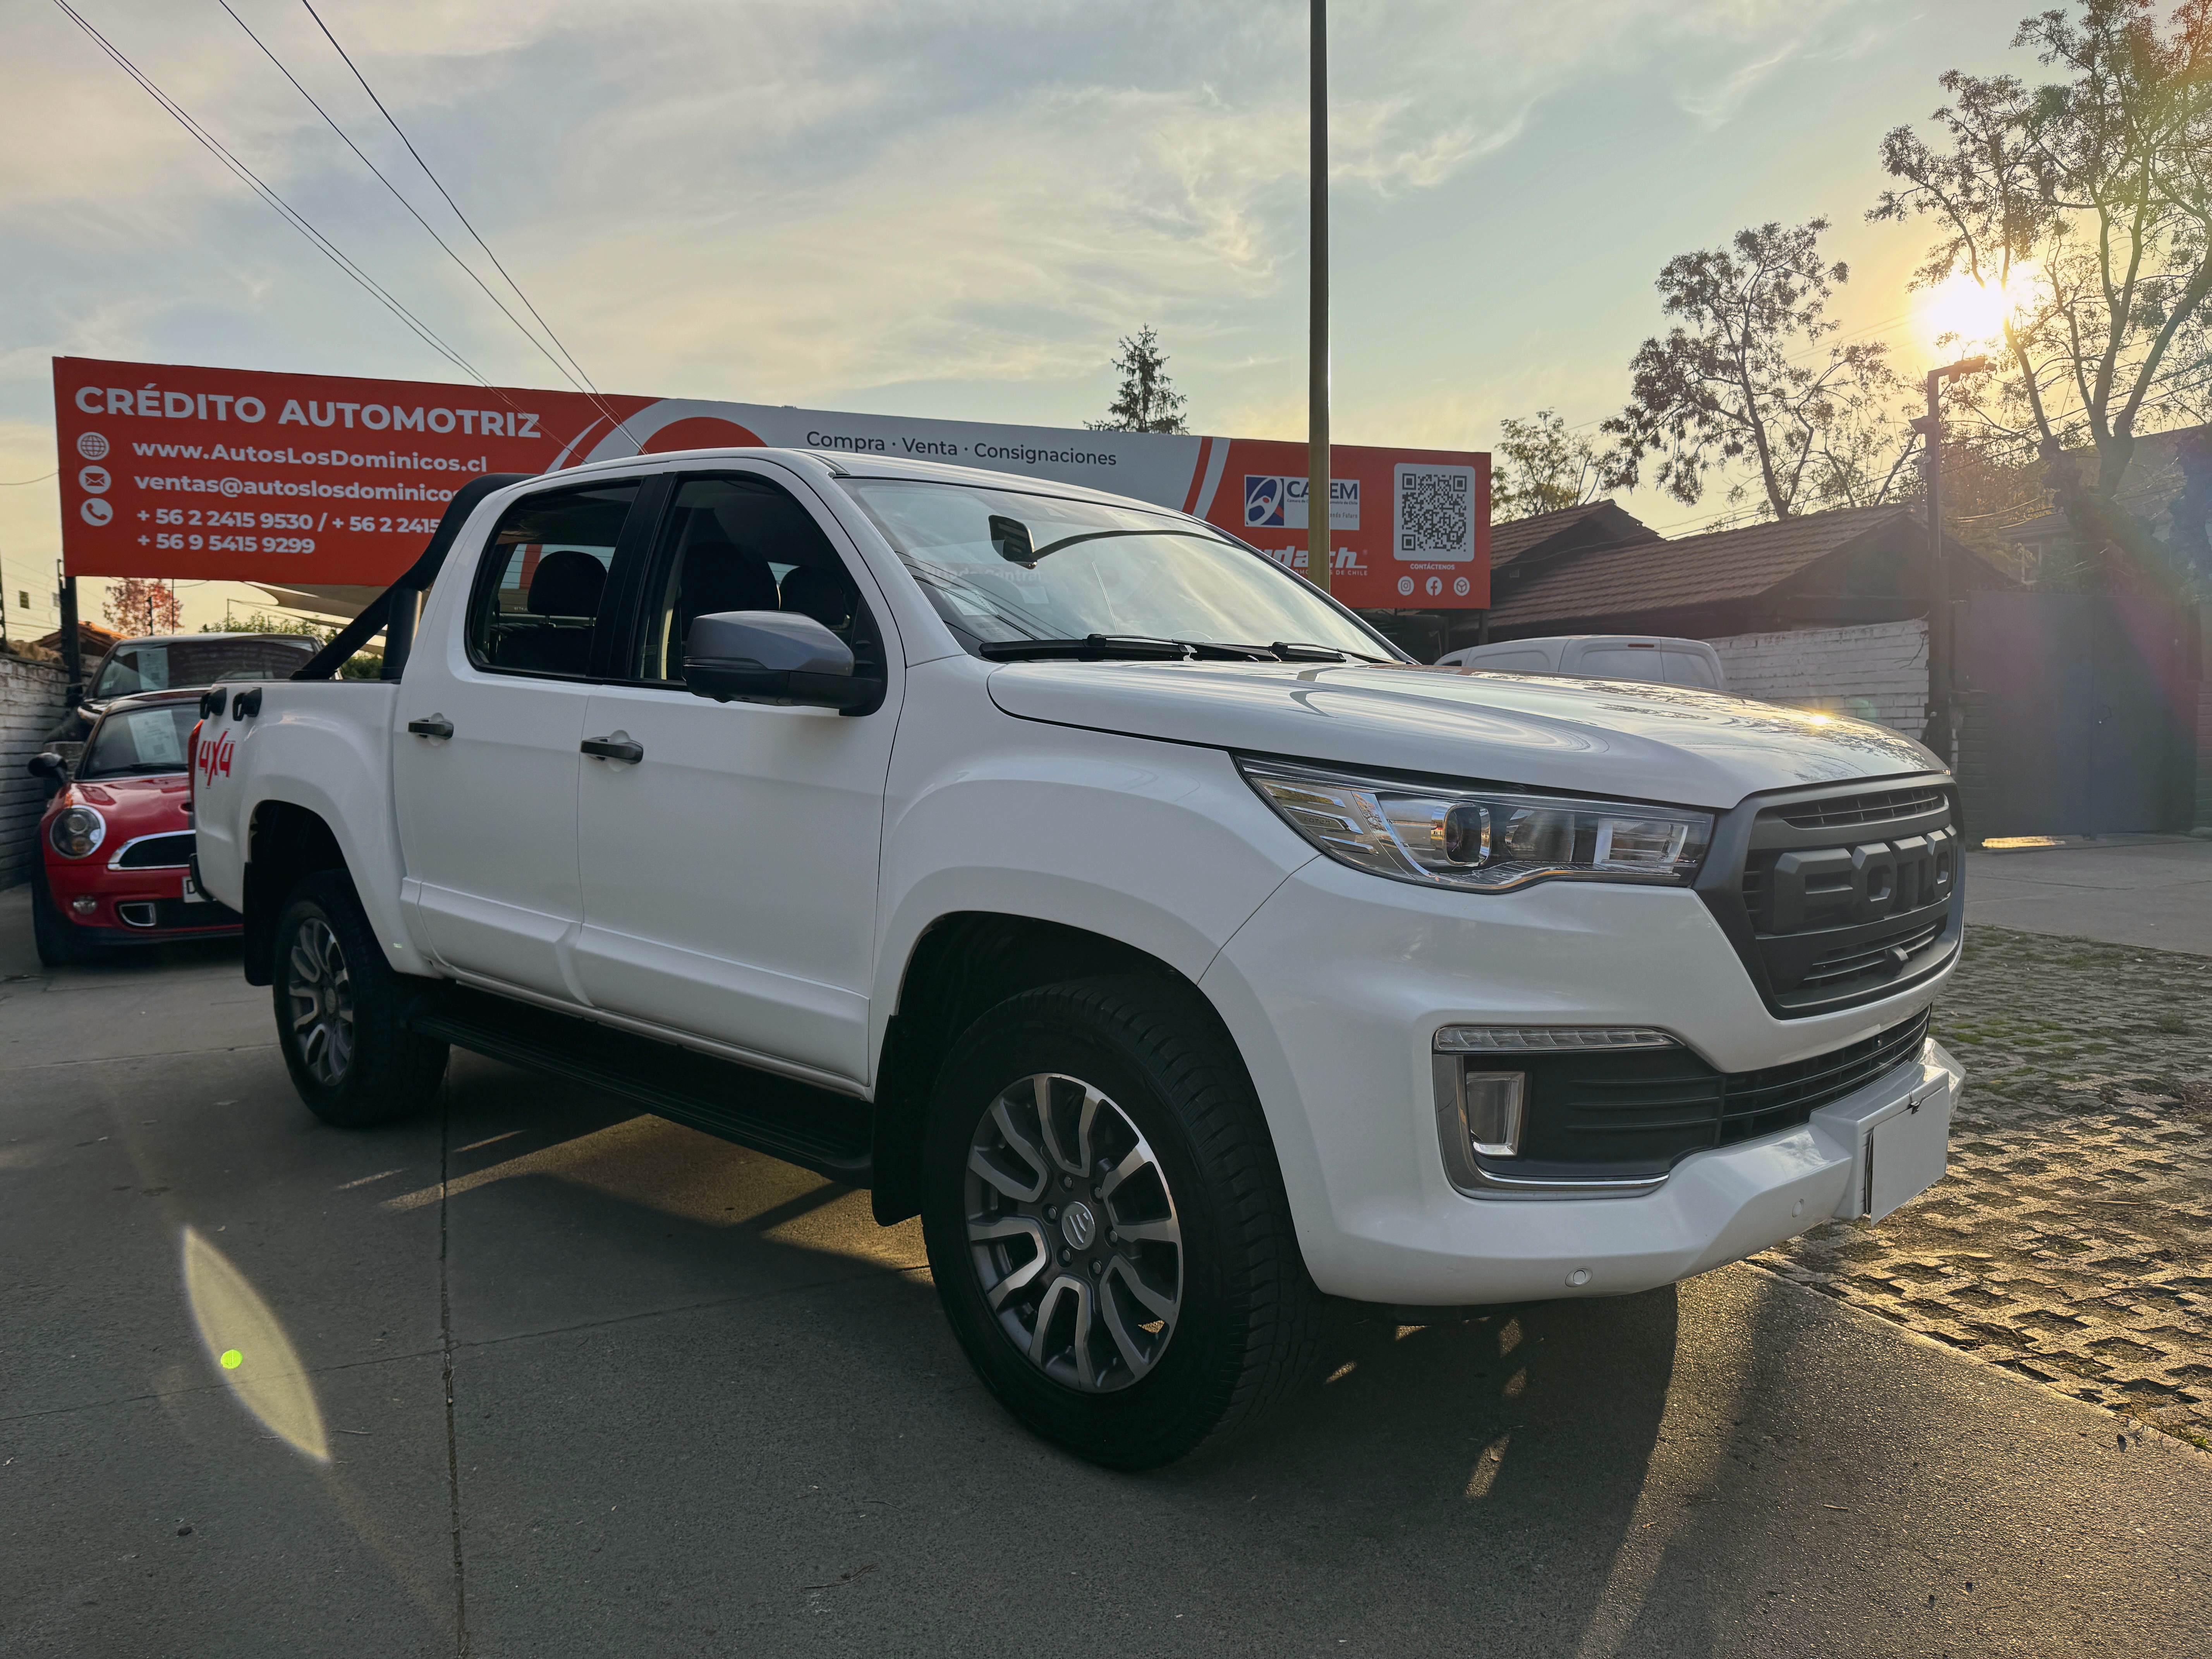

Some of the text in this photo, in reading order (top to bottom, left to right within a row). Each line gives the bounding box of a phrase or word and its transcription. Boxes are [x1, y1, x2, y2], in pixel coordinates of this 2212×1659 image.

[75, 383, 541, 438] CRÉDITO AUTOMOTRIZ
[132, 442, 487, 473] www.AutosLosDominicos.cl
[806, 431, 1117, 466] Compra Venta Consignaciones
[134, 476, 460, 502] ventas@autoslosdominico
[1286, 481, 1358, 500] CAEM
[156, 508, 184, 525] 56
[188, 510, 202, 526] 2
[206, 510, 256, 528] 2415
[260, 512, 313, 530] 9530
[349, 516, 375, 532] 56
[379, 517, 392, 532] 2
[396, 517, 441, 534] 2415
[156, 533, 184, 549] 56
[189, 534, 203, 550] 9
[209, 535, 258, 552] 5415
[262, 536, 316, 554] 9299
[1773, 823, 1958, 934] FOTO
